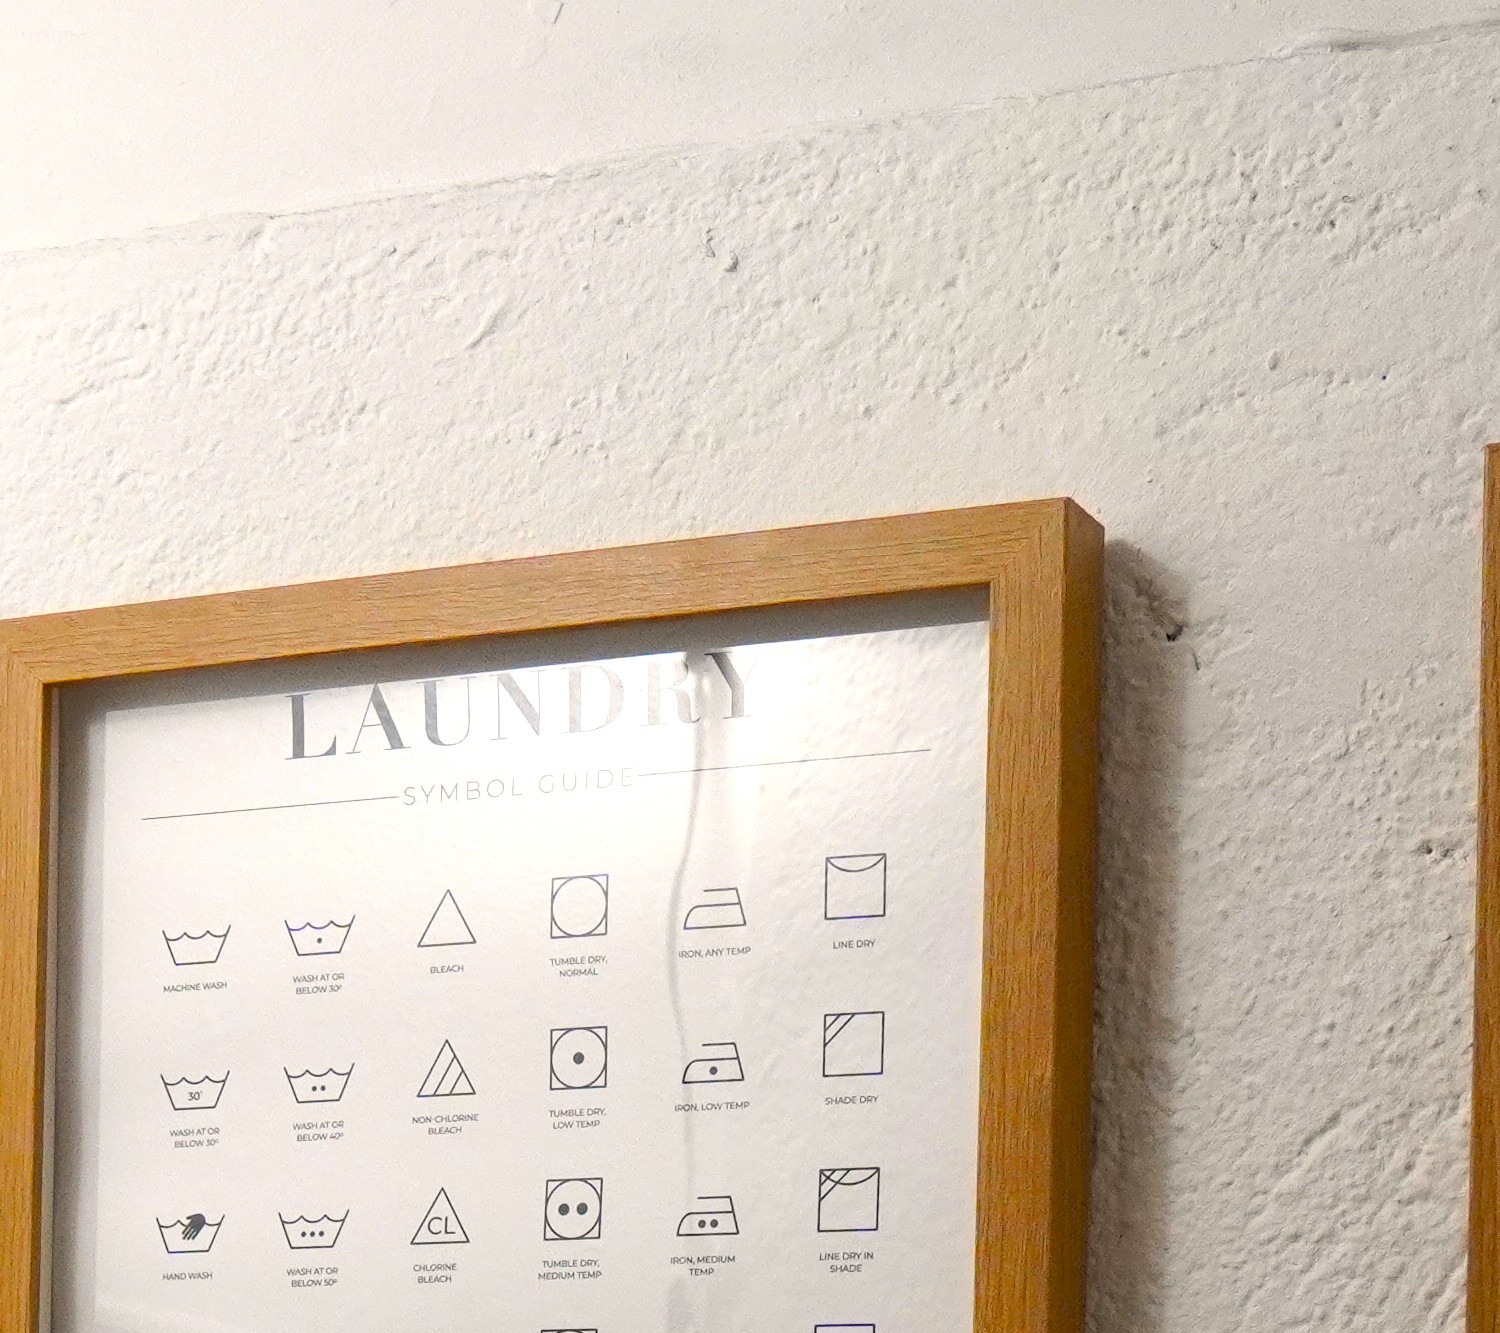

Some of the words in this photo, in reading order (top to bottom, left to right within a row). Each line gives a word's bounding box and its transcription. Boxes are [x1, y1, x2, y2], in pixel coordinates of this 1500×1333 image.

[285, 651, 759, 761] LAUNDRY
[403, 778, 523, 806] SYMBOL
[539, 767, 633, 794] GUIDE
[832, 939, 854, 949] LINE
[856, 939, 875, 948] DRY
[549, 956, 585, 966] TUMBLE
[430, 964, 464, 974] BLEACH
[559, 968, 598, 977] NORMAL
[163, 982, 200, 993] MACHINE
[202, 981, 227, 990] WASH
[412, 1113, 479, 1124] NON-CHLORINE
[428, 1126, 462, 1135] BLEACH
[427, 1216, 456, 1235] CL
[696, 1255, 735, 1263] MEDIUM
[162, 1272, 186, 1280] HAND
[187, 1271, 213, 1279] WASH
[689, 1267, 714, 1276] TEMP
